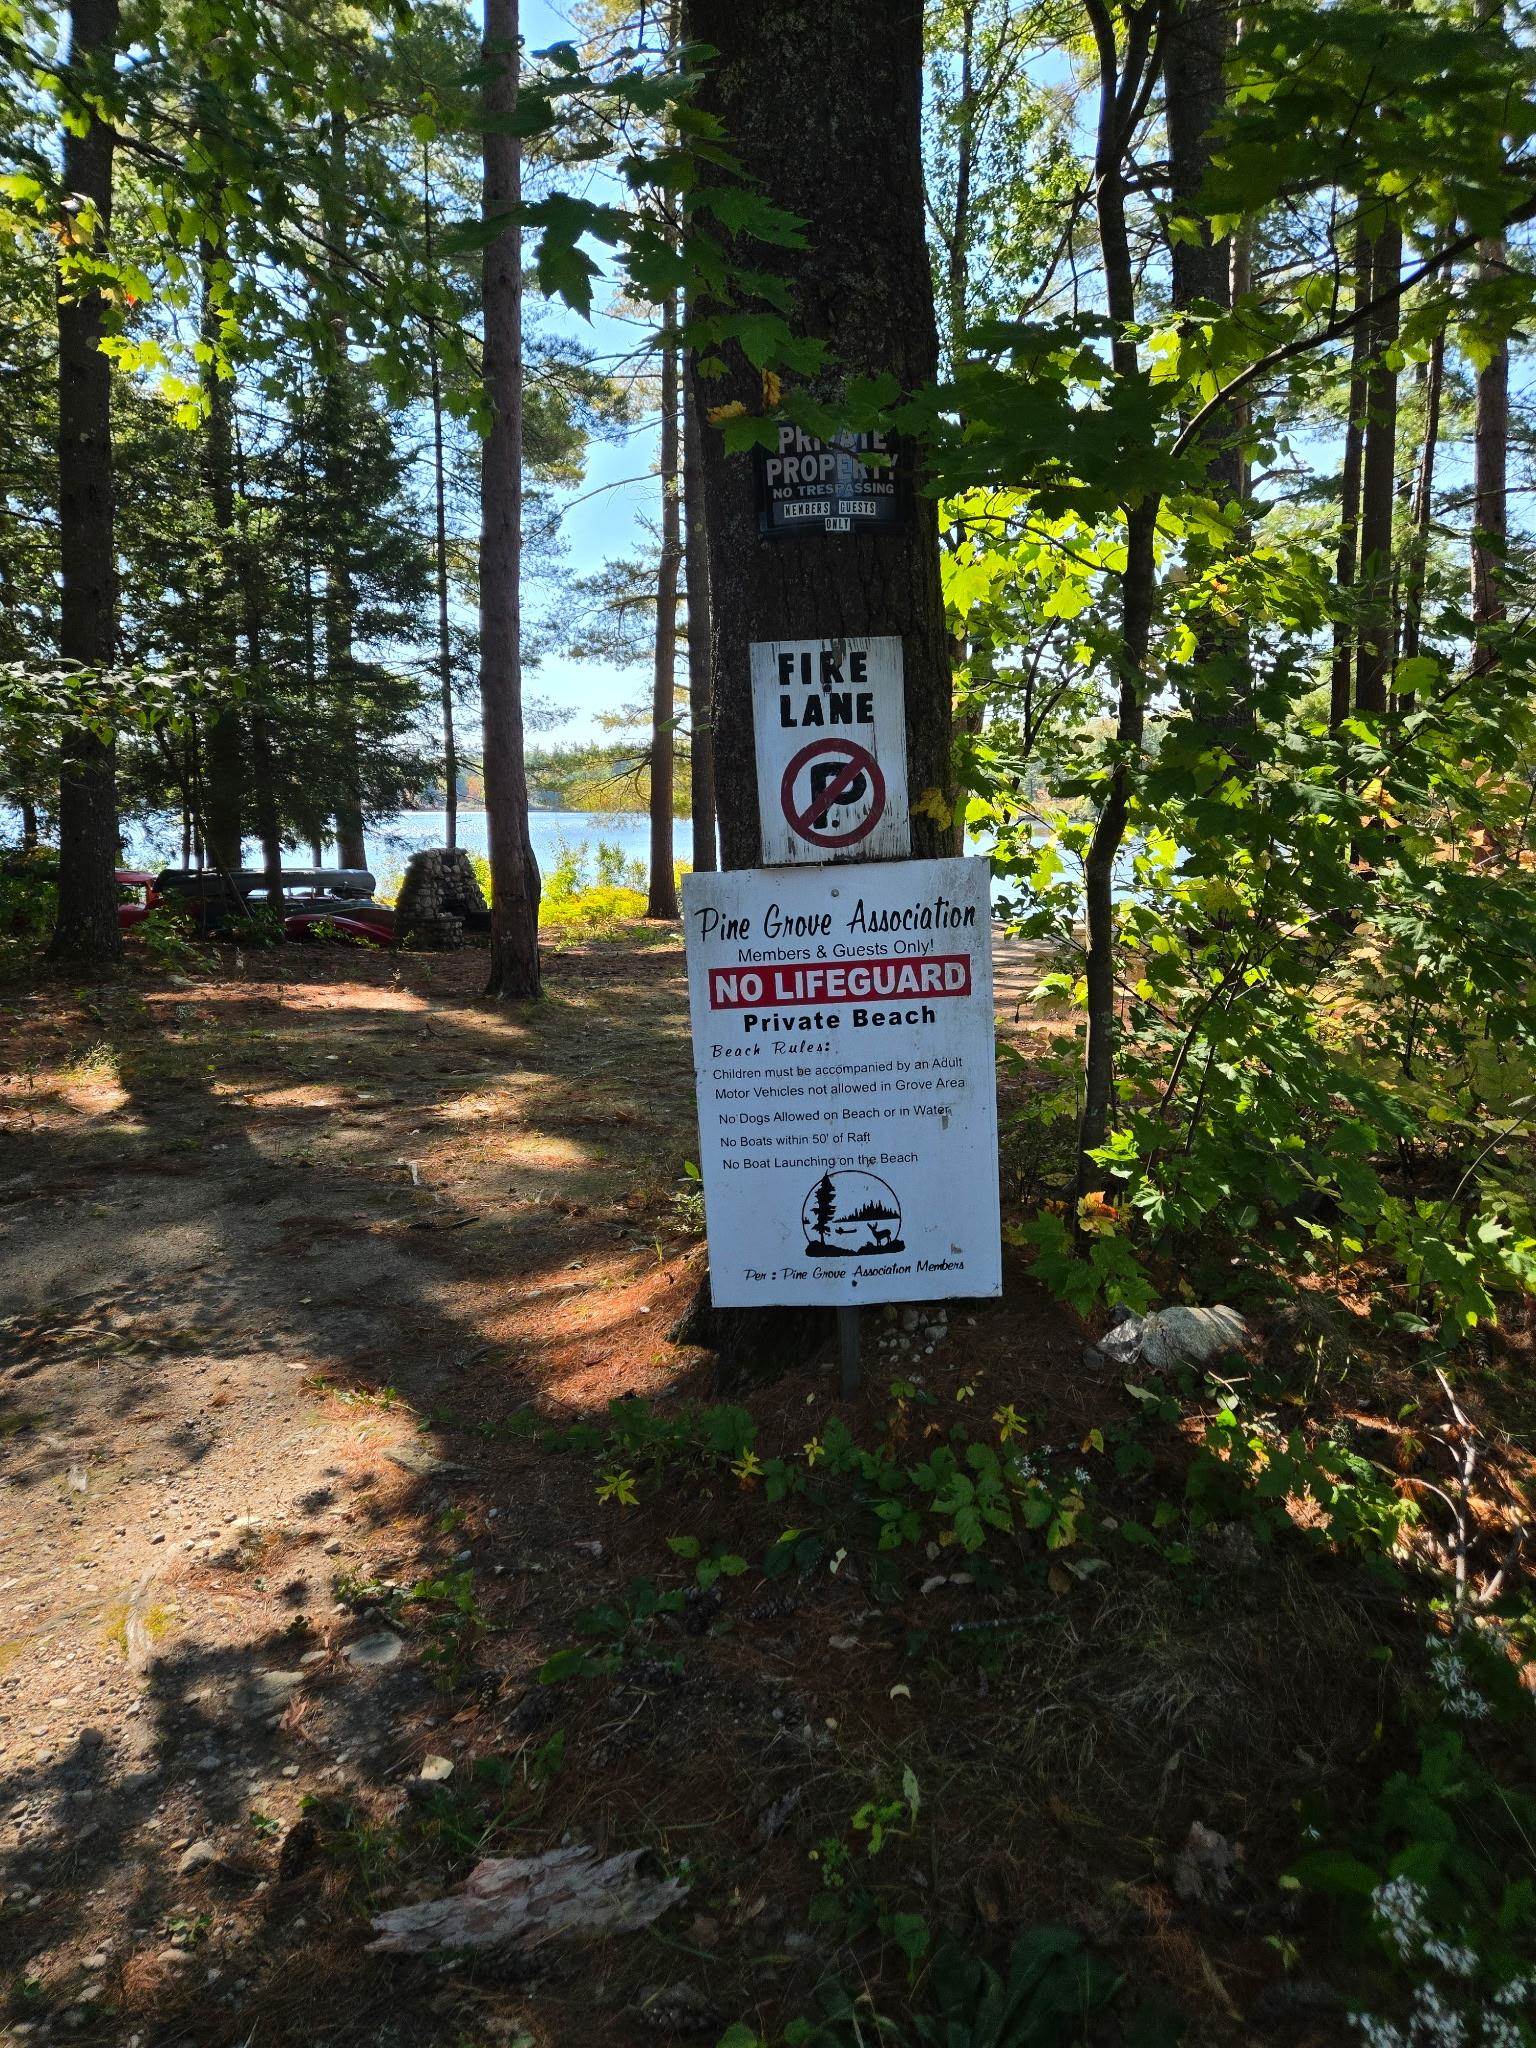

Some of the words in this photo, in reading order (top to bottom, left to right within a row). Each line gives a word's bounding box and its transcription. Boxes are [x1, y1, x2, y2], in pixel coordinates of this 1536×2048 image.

[779, 426, 888, 453] PRIATE
[773, 487, 792, 498] NO
[798, 483, 894, 497] TRESPASSING
[784, 502, 829, 517] MEMBERS
[840, 501, 875, 514] GUESTS
[826, 519, 849, 530] ONLY
[778, 651, 867, 685] FIRE
[780, 692, 874, 727] LANE
[694, 907, 750, 942] Pine
[764, 903, 832, 938] Grove
[847, 896, 975, 934] Association
[738, 948, 810, 963] Members
[816, 946, 827, 958] &
[832, 942, 888, 957] Guests
[893, 938, 934, 955] Only!
[715, 973, 763, 1004] NO
[774, 962, 966, 1000] LIFEGUARD
[744, 1011, 840, 1032] Private
[853, 1006, 936, 1028] Beach
[711, 1044, 761, 1058] Beach
[772, 1041, 830, 1055] Rules:
[713, 1067, 761, 1080] Children
[765, 1066, 794, 1077] must
[797, 1066, 812, 1077] be
[815, 1060, 893, 1075] accompanied
[897, 1060, 911, 1072] by
[914, 1061, 929, 1069] an
[932, 1057, 963, 1069] Adult
[715, 1088, 750, 1099] Motor
[753, 1086, 804, 1098] Vehicles
[808, 1084, 827, 1095] not
[831, 1082, 877, 1095] allowed
[881, 1081, 891, 1091] in
[895, 1079, 932, 1091] Grove
[936, 1077, 965, 1089] Area
[719, 1114, 736, 1124] No
[739, 1112, 770, 1126] Dogs
[773, 1110, 820, 1122] Allowed
[823, 1111, 838, 1120] on
[842, 1107, 880, 1119] Beach
[883, 1107, 896, 1117] or
[899, 1106, 910, 1116] in
[913, 1105, 949, 1116] Water
[720, 1137, 737, 1147] No
[740, 1136, 773, 1147] Boats
[776, 1134, 809, 1145] within
[812, 1133, 829, 1144] 50'
[832, 1132, 844, 1143] of
[847, 1131, 871, 1142] Raft
[722, 1159, 740, 1170] No
[744, 1158, 770, 1169] Boat
[774, 1155, 836, 1169] Launching
[839, 1156, 854, 1166] on
[858, 1154, 876, 1166] the
[880, 1152, 918, 1164] Beach
[744, 1268, 766, 1281] Per
[782, 1267, 807, 1280] Pine
[812, 1267, 846, 1280] Grove
[853, 1263, 911, 1278] Association
[916, 1259, 965, 1273] Members
